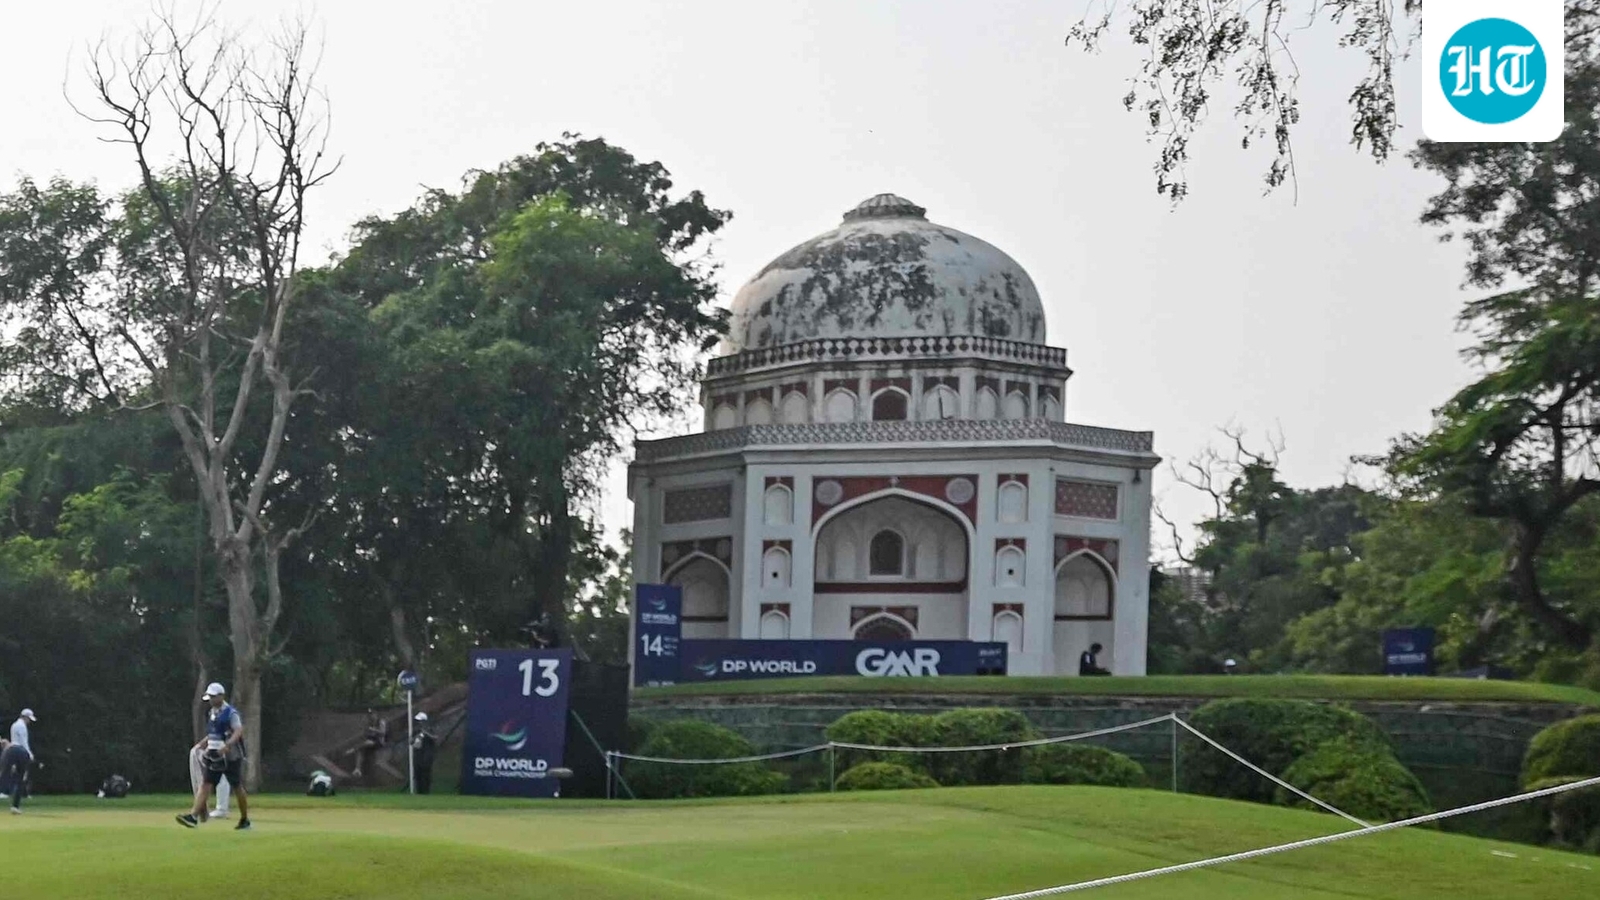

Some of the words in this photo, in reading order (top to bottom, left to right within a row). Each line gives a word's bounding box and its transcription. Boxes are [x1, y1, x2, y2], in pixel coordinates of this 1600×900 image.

[641, 633, 663, 656] 14
[722, 660, 747, 673] DP
[750, 660, 817, 673] WORLD
[855, 648, 941, 677] GMR
[518, 659, 560, 697] 13
[475, 757, 494, 769] DP
[495, 758, 548, 772] WORLD
